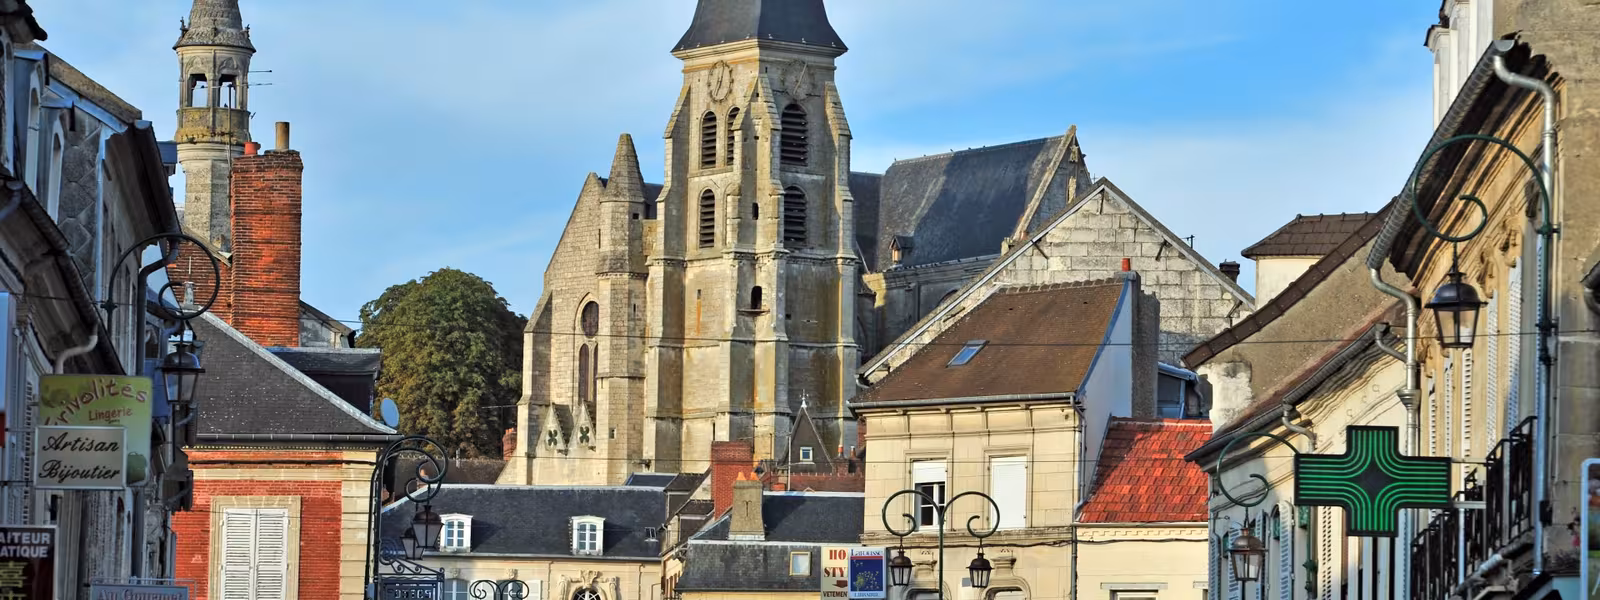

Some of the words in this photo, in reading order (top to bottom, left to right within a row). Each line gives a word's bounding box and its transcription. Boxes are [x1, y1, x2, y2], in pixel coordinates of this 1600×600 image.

[88, 407, 132, 422] Lingerie
[42, 432, 119, 452] Artisan
[39, 459, 120, 484] Bijoutier
[0, 545, 48, 558] ATIQUE
